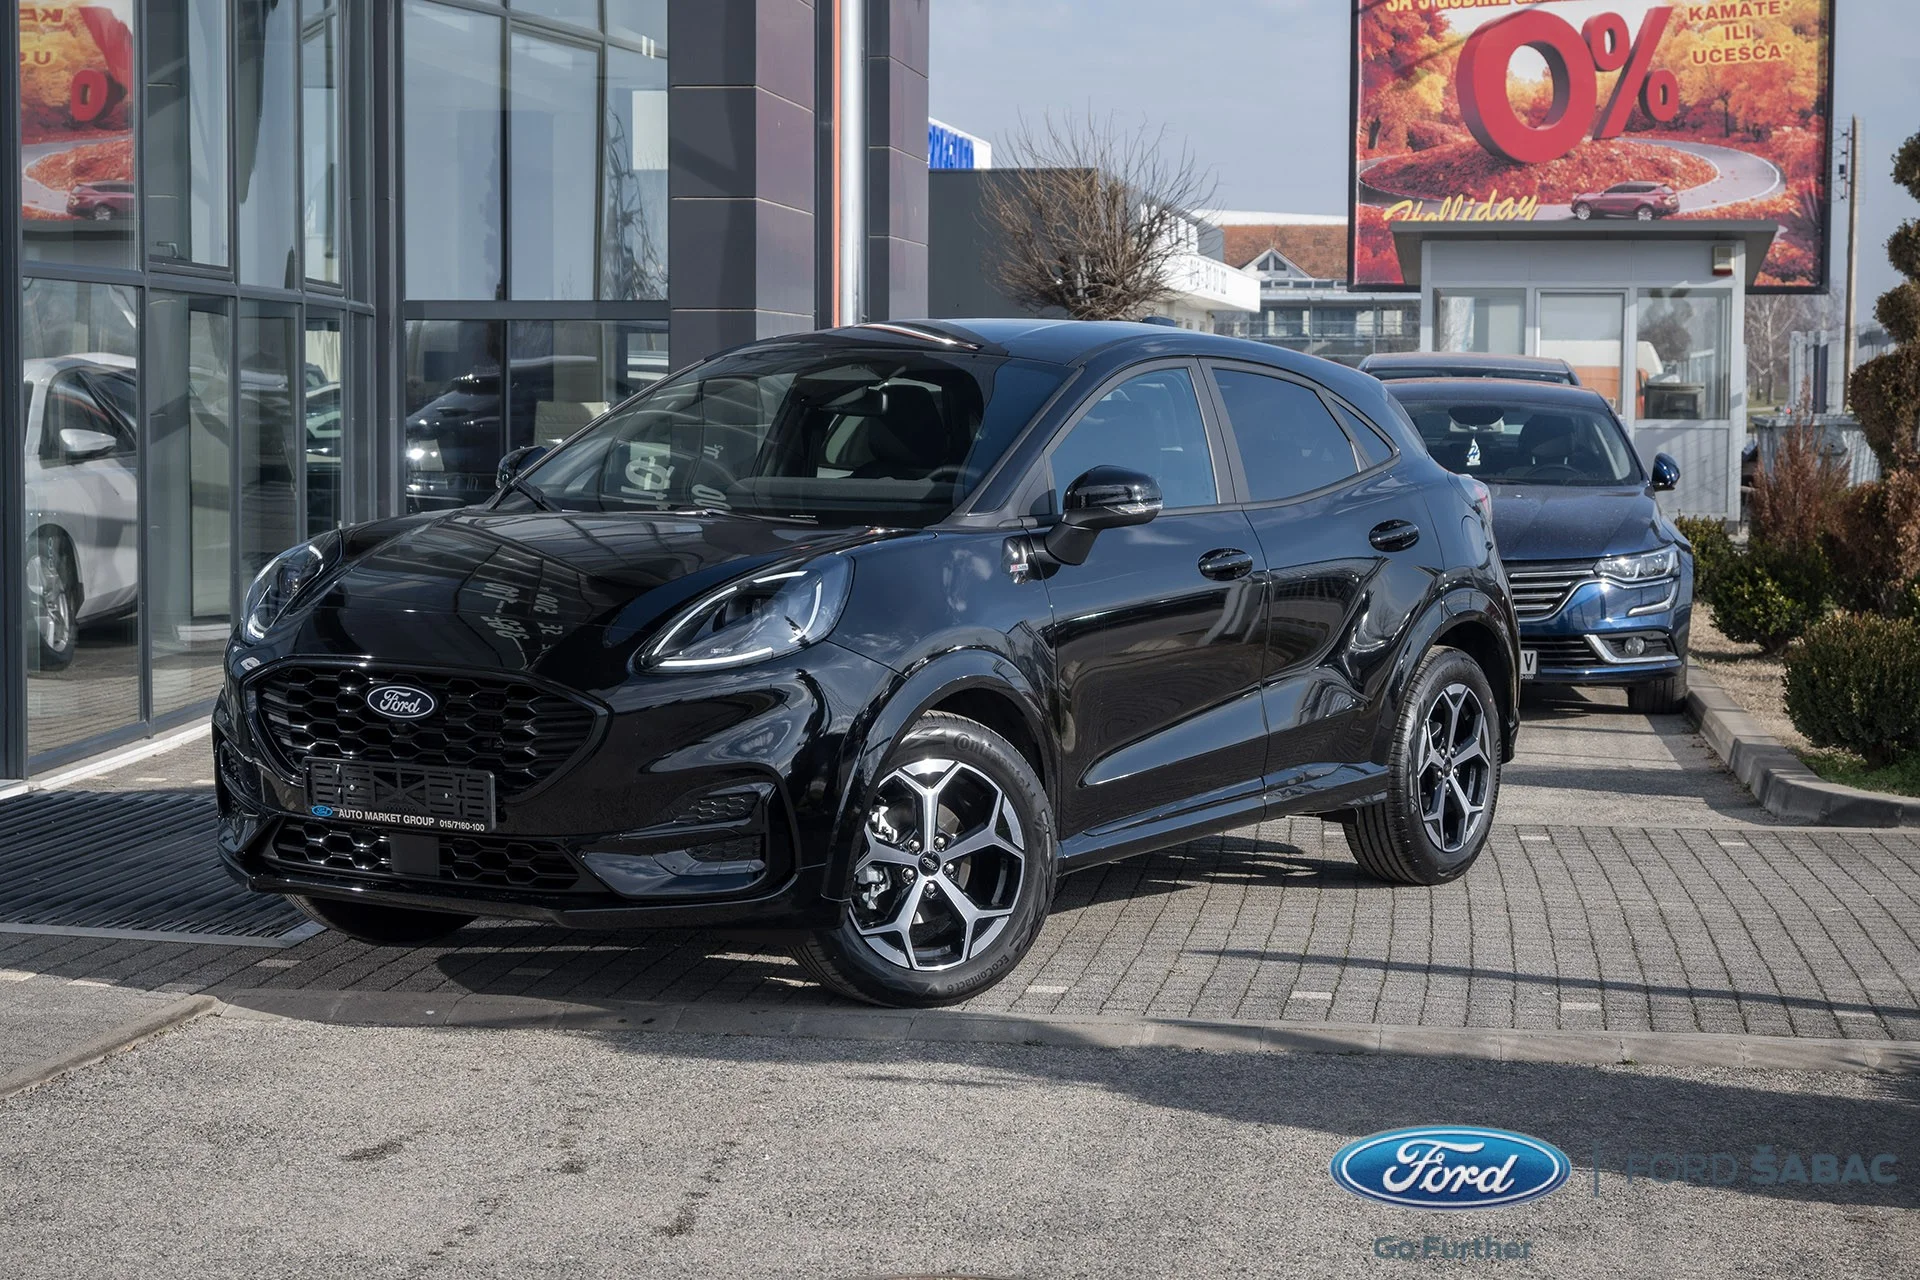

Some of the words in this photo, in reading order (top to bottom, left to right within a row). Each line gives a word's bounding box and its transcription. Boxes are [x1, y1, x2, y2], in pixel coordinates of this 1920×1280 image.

[1724, 24, 1751, 41] ILI
[1456, 6, 1679, 164] 0%
[379, 689, 420, 713] Ford
[338, 808, 363, 821] AUTO
[364, 811, 401, 824] MARKET
[403, 815, 435, 827] GROUP
